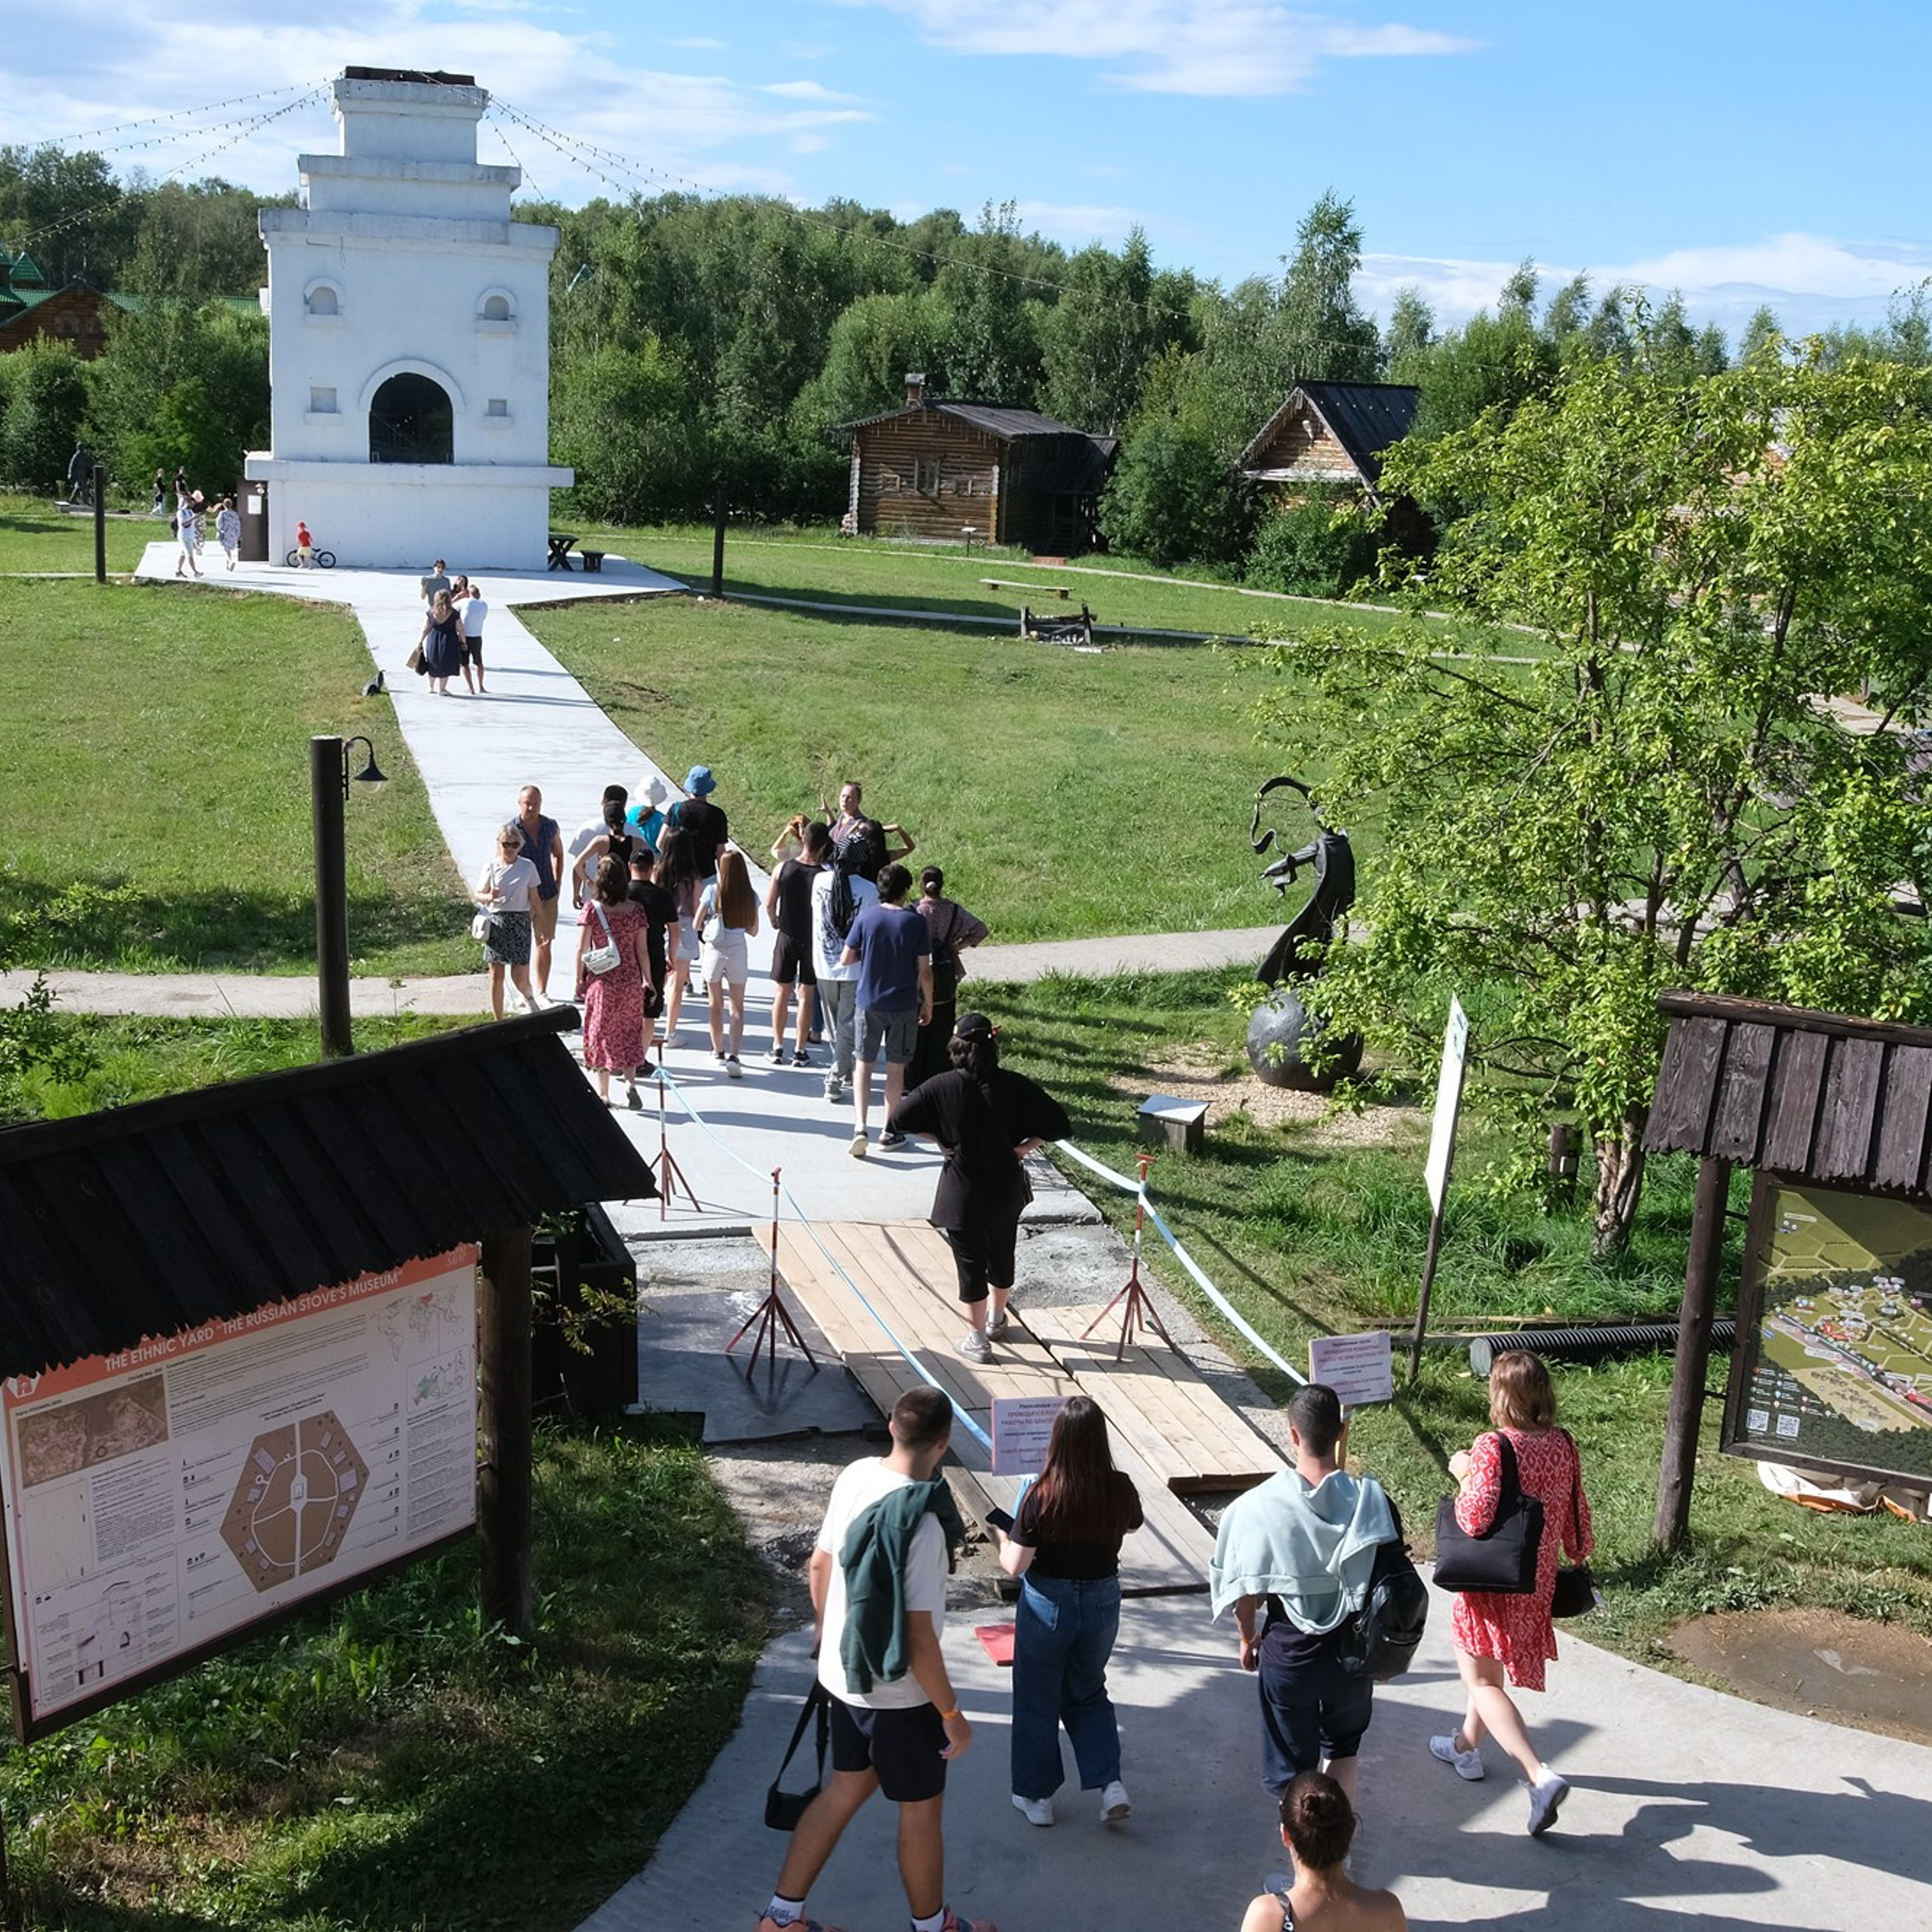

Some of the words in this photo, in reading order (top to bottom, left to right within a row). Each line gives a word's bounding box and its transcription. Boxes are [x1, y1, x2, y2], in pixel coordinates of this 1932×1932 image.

[105, 1354, 128, 1372] THE
[131, 1339, 177, 1364] ETHNIC
[179, 1327, 214, 1348] YARD
[246, 1301, 297, 1327] RUSSIAN
